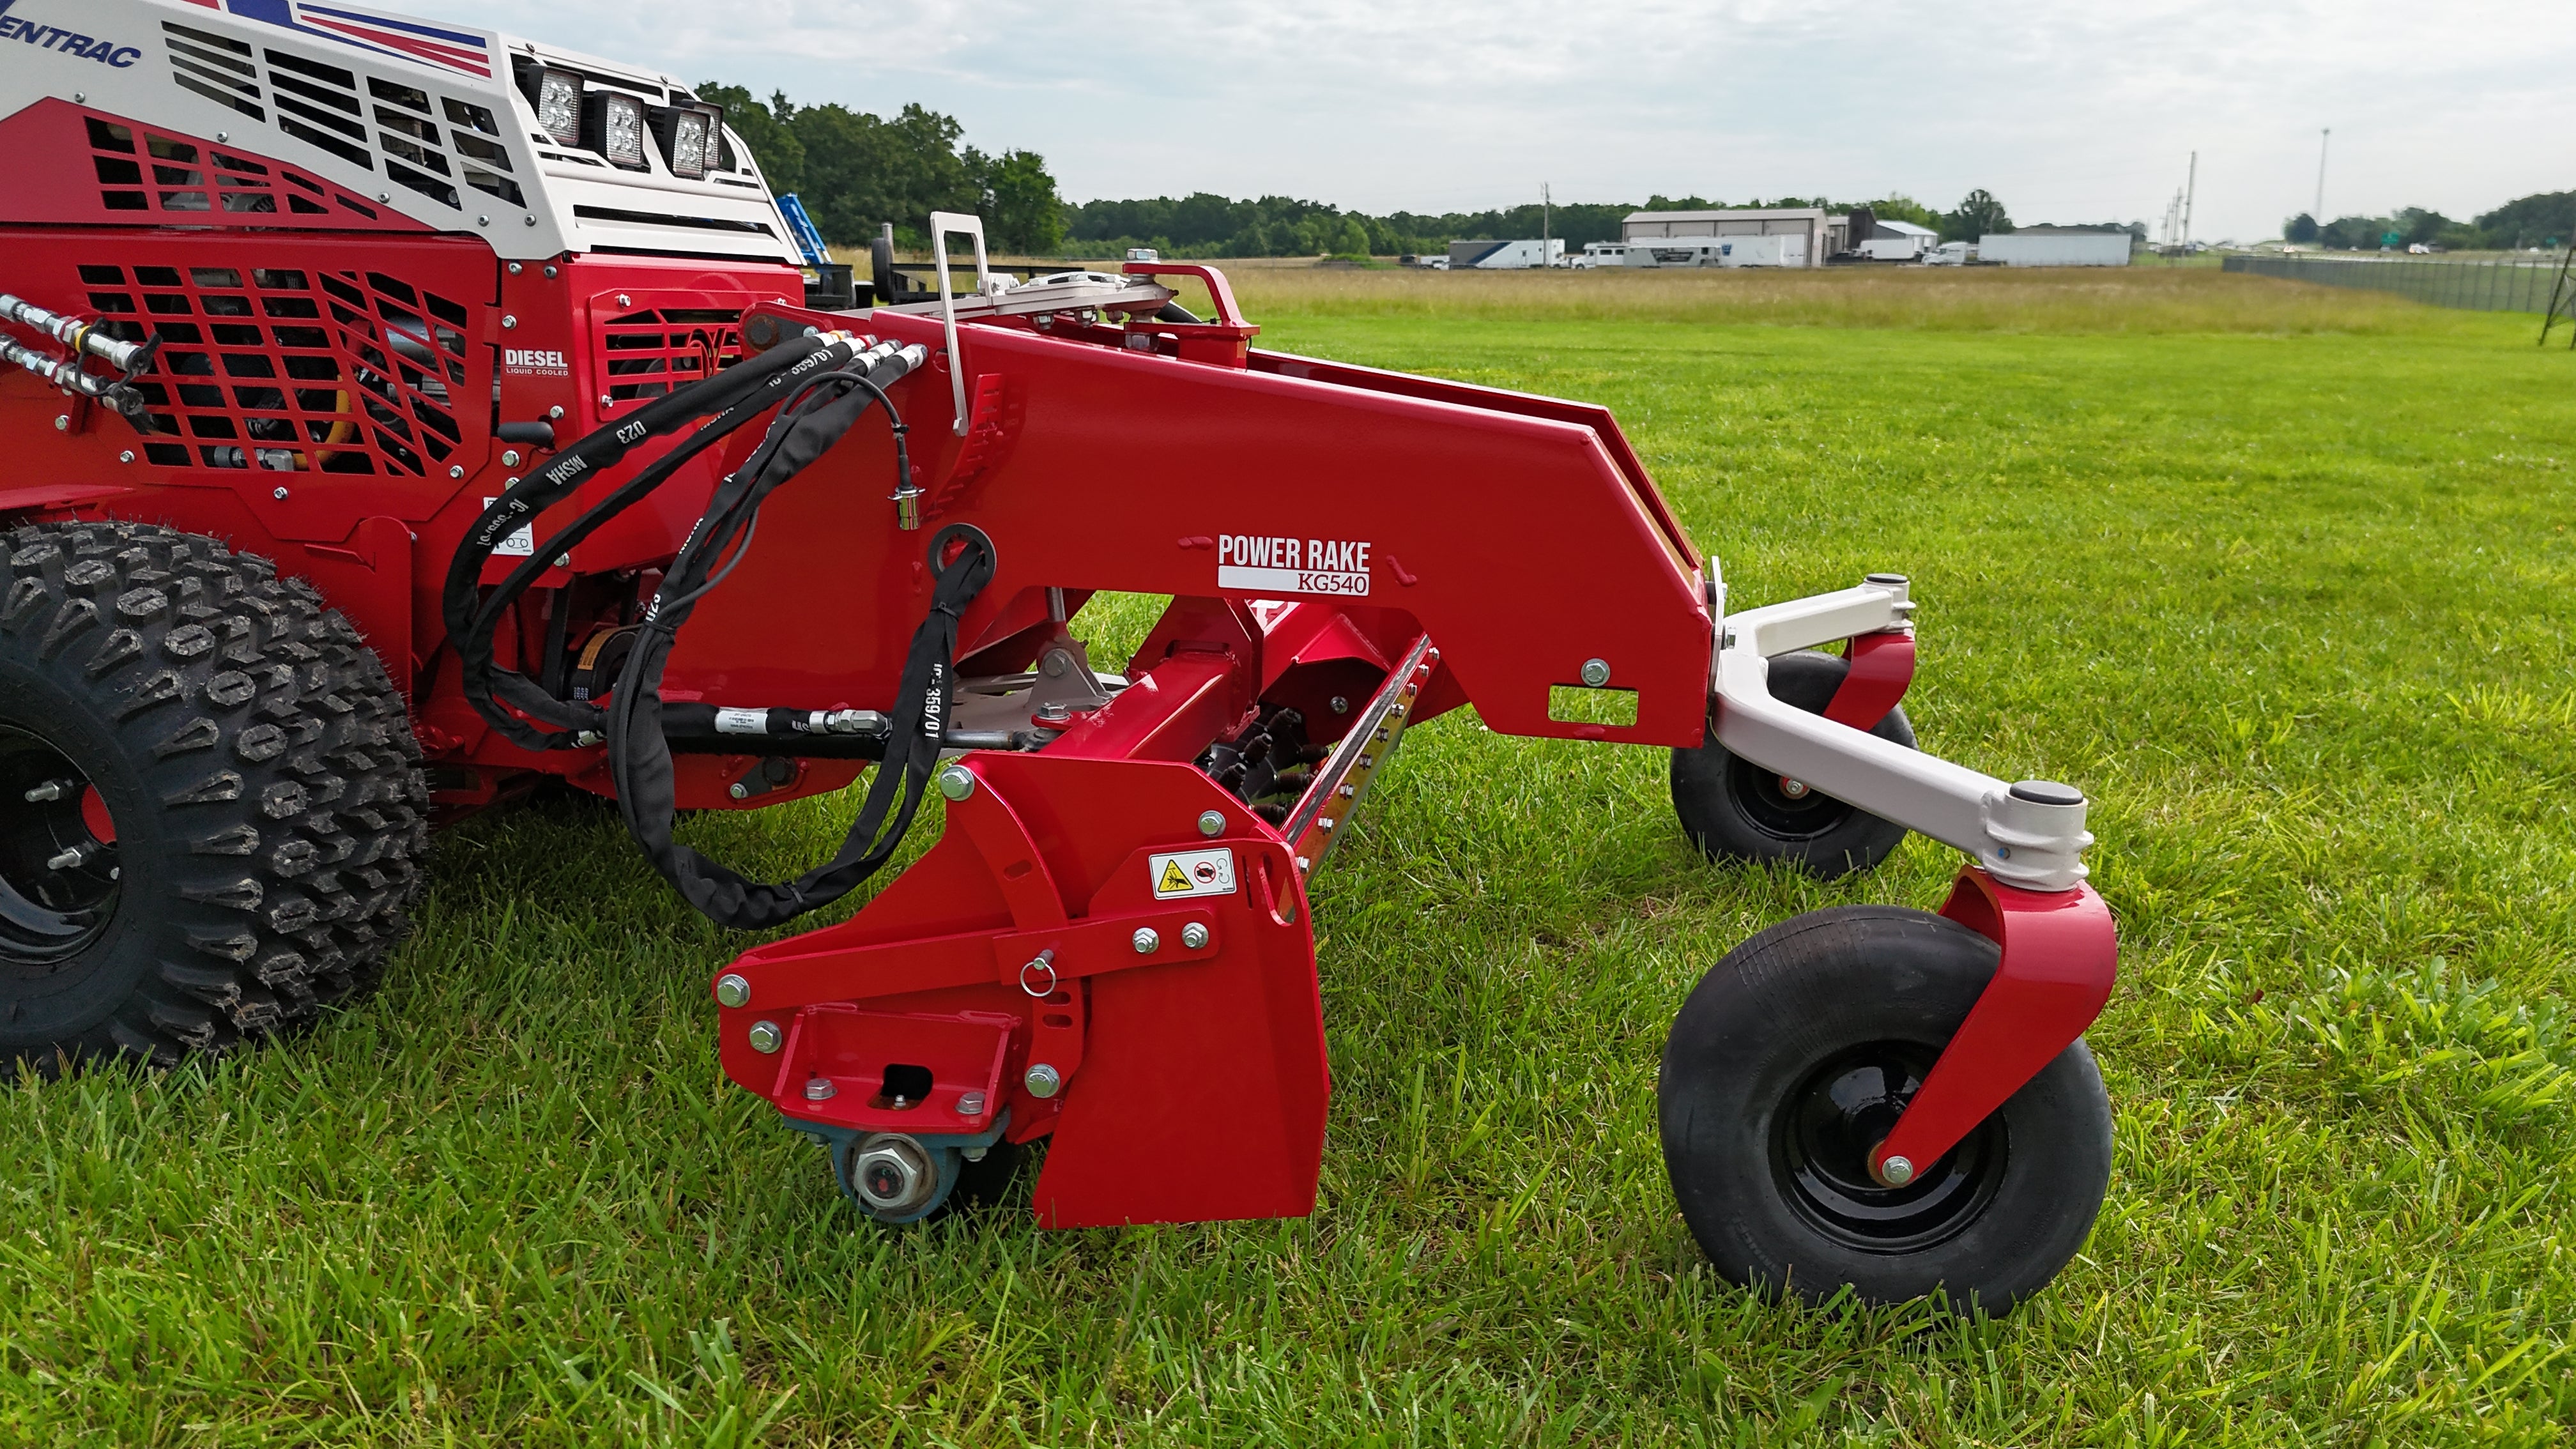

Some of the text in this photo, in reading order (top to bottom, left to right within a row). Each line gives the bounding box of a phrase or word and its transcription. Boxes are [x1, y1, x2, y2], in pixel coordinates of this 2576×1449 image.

[505, 349, 568, 367] DIESEL
[546, 455, 588, 486] MSHA
[1218, 534, 1371, 572] POWER RAKE
[1298, 573, 1367, 594] KG540
